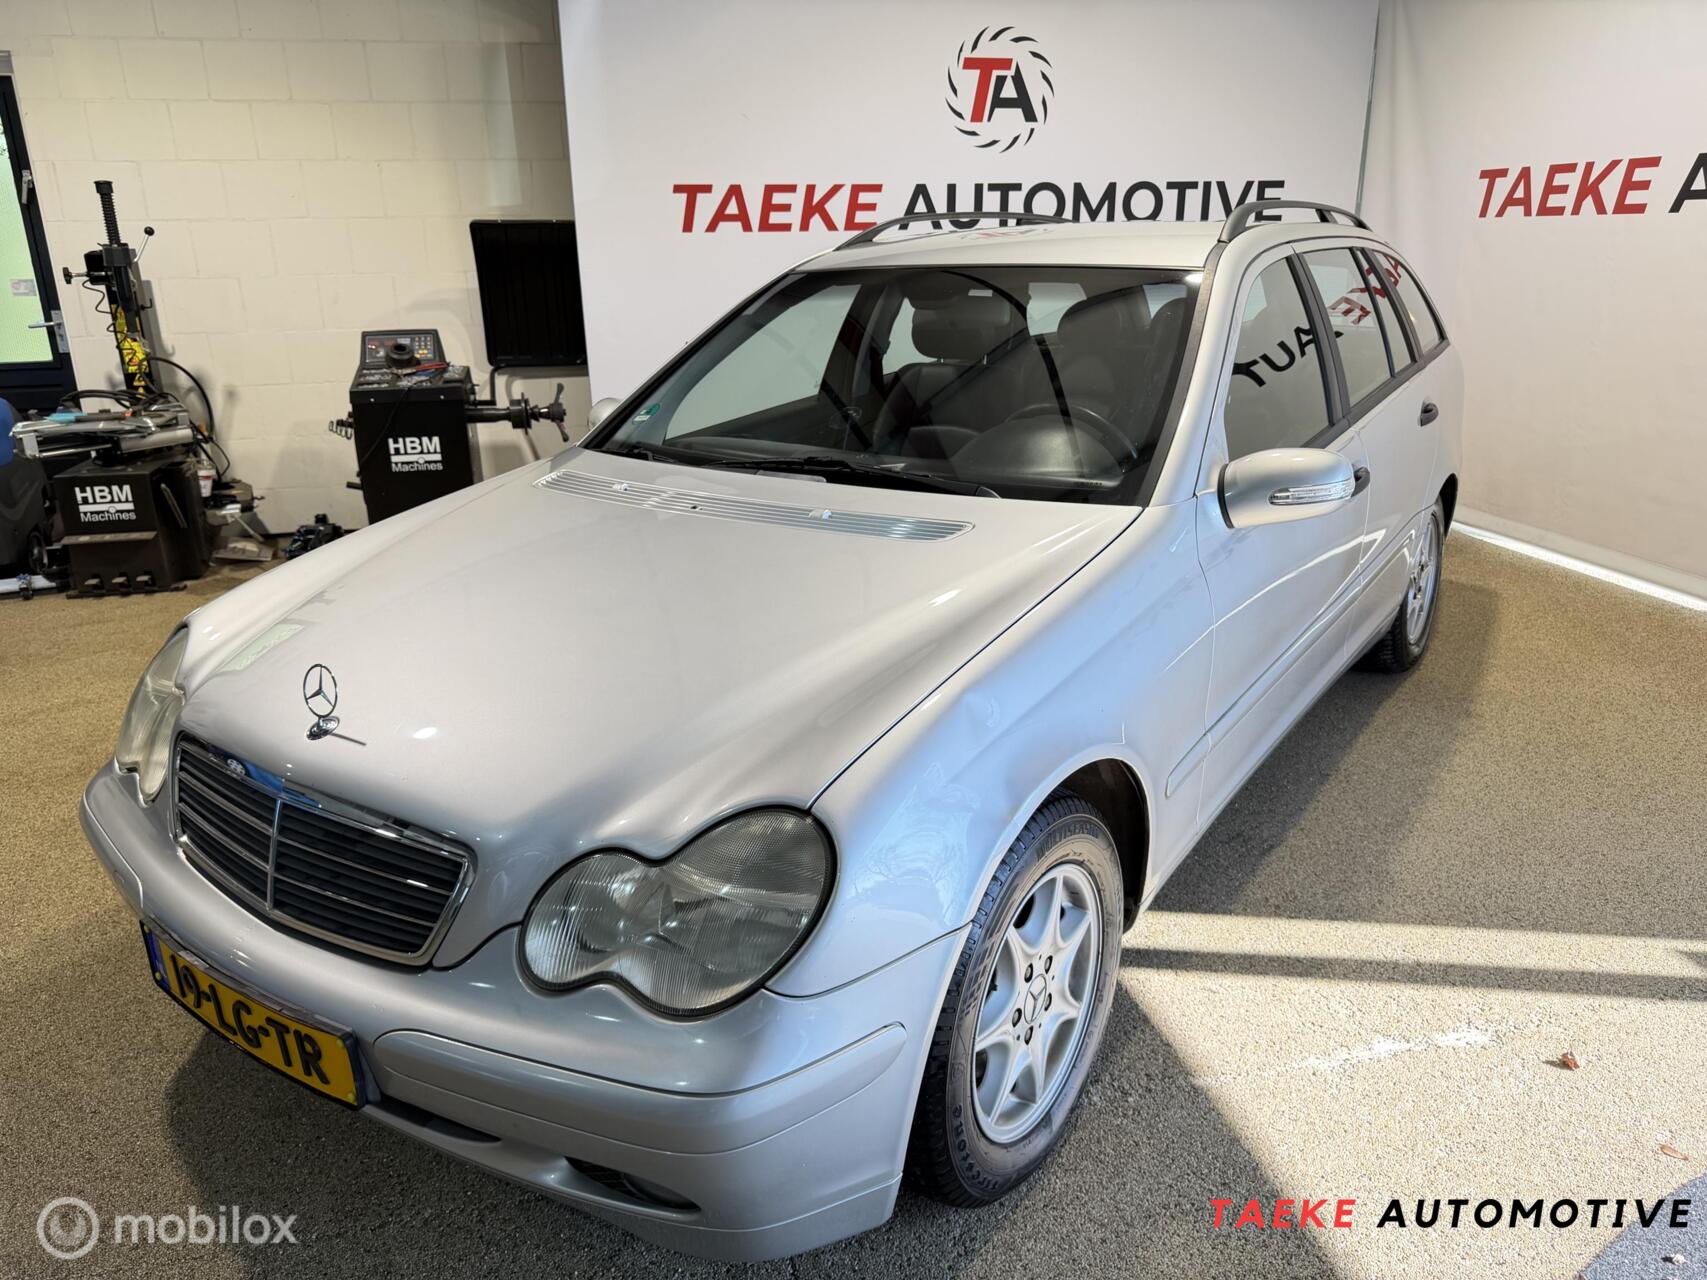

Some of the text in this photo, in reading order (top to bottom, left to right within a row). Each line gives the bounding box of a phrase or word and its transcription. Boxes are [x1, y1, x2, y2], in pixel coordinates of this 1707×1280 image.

[962, 57, 1038, 123] TA
[1478, 156, 1662, 218] TAEKE
[672, 180, 1286, 233] TAEKE AUTOMOTIVE
[388, 436, 441, 454] HBM
[391, 461, 443, 473] Machines
[74, 484, 133, 504] HBM
[80, 511, 137, 522] Machines
[169, 954, 331, 1085] 19-LG-TR
